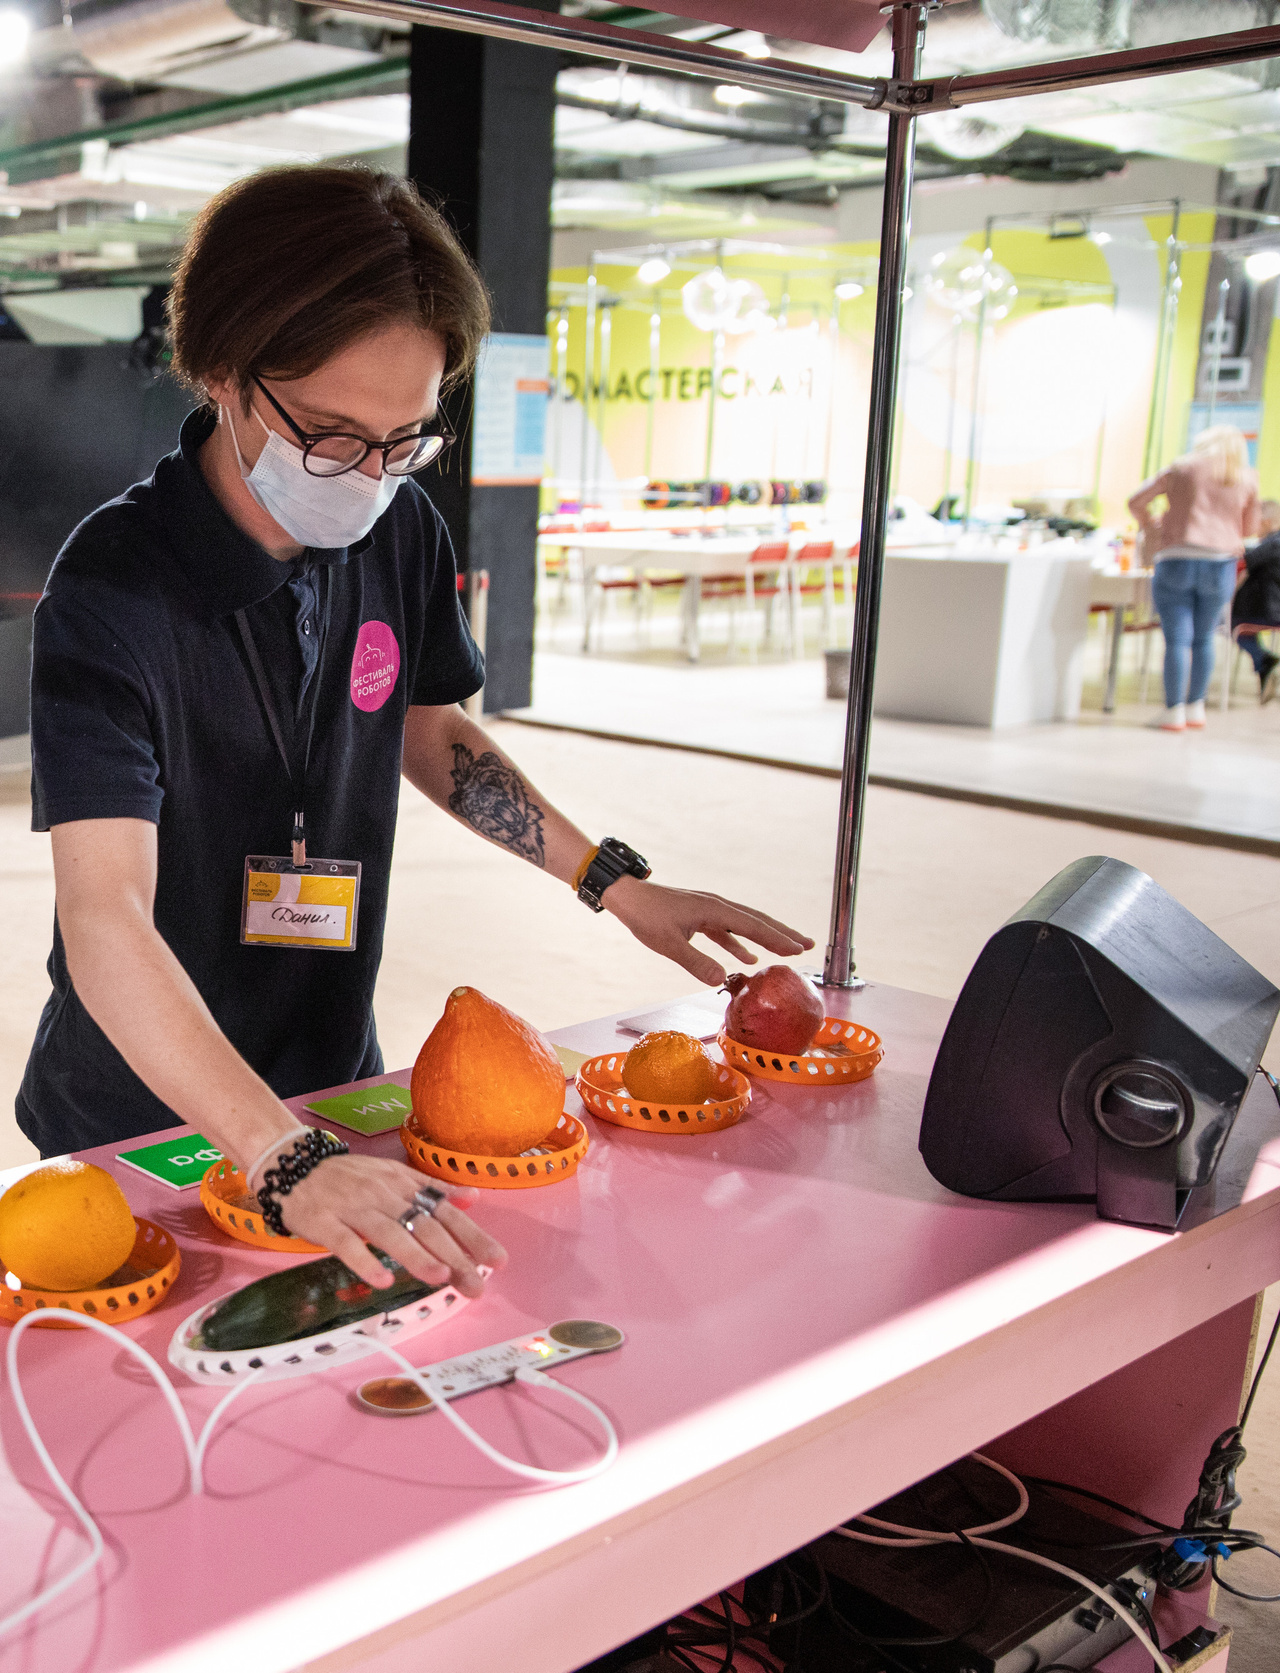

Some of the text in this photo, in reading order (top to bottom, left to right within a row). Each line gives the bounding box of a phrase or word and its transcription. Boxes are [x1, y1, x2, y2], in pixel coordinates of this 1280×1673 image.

[547, 366, 814, 403] ОМАСТЕРСКАЯ
[353, 664, 394, 688] ФЕСТИВАЛЬ
[357, 676, 391, 698] РОБОТОВ
